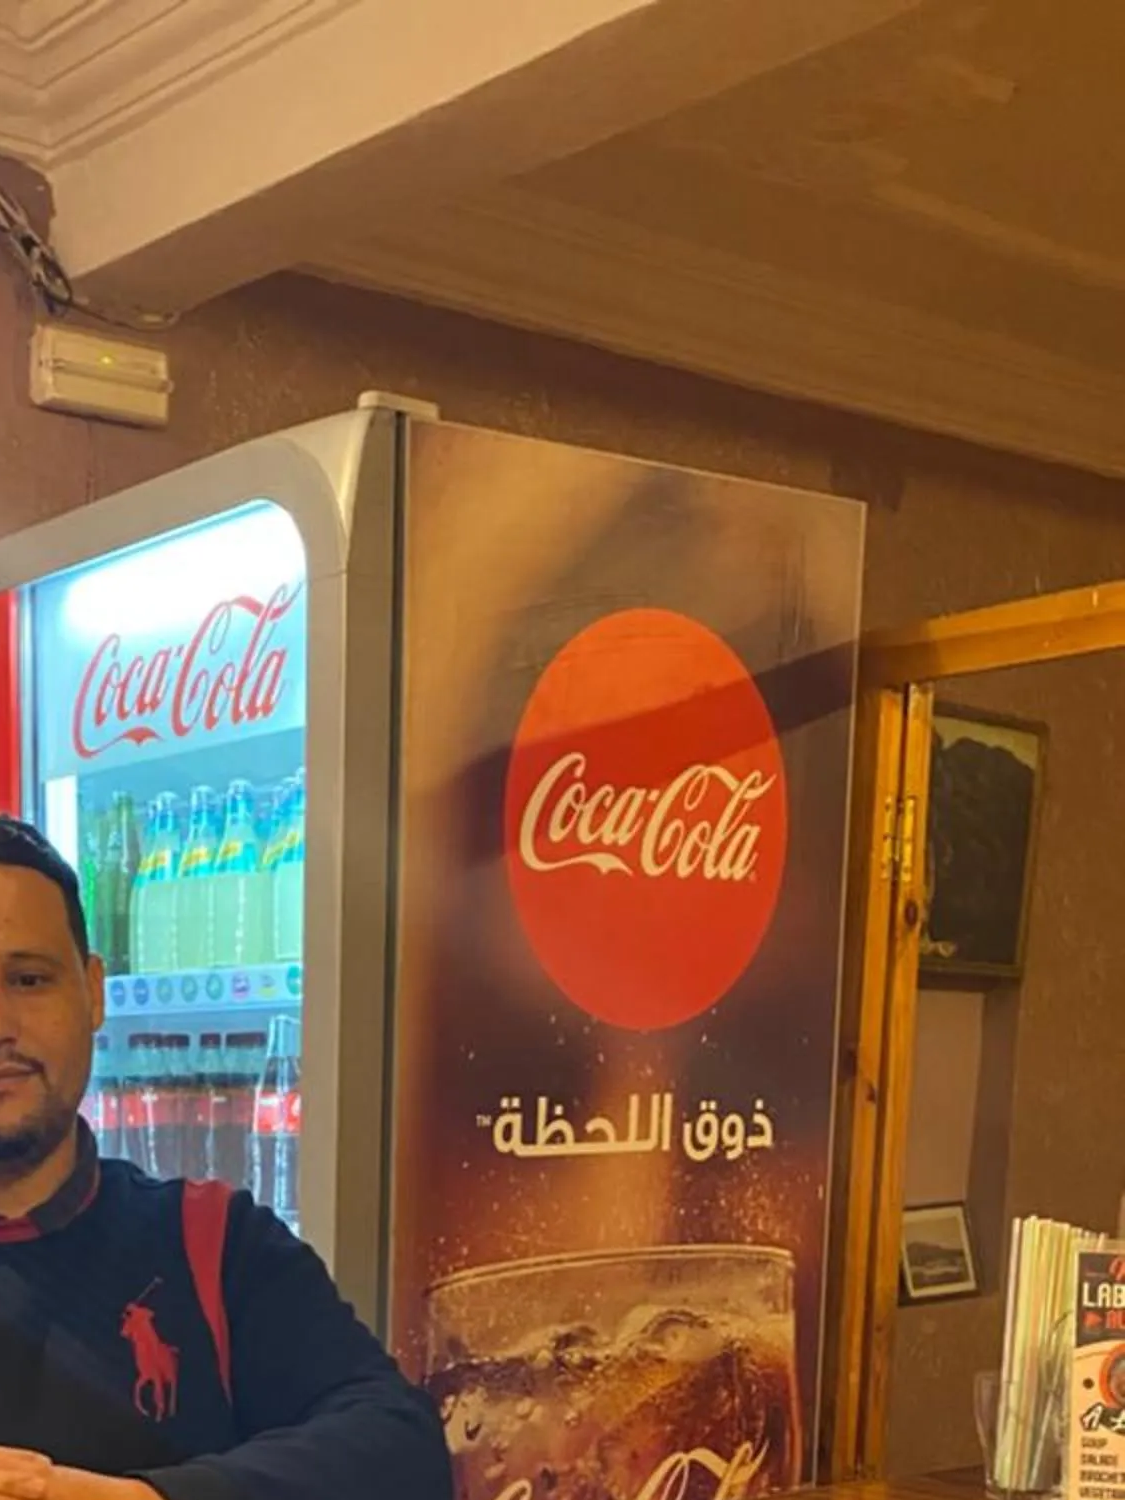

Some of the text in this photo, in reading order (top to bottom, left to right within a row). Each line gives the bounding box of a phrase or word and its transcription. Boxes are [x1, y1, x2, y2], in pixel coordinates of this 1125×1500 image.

[520, 752, 777, 881] Coca-Cola
[493, 1093, 673, 1157] اللحظة
[683, 1099, 773, 1162] ذوق
